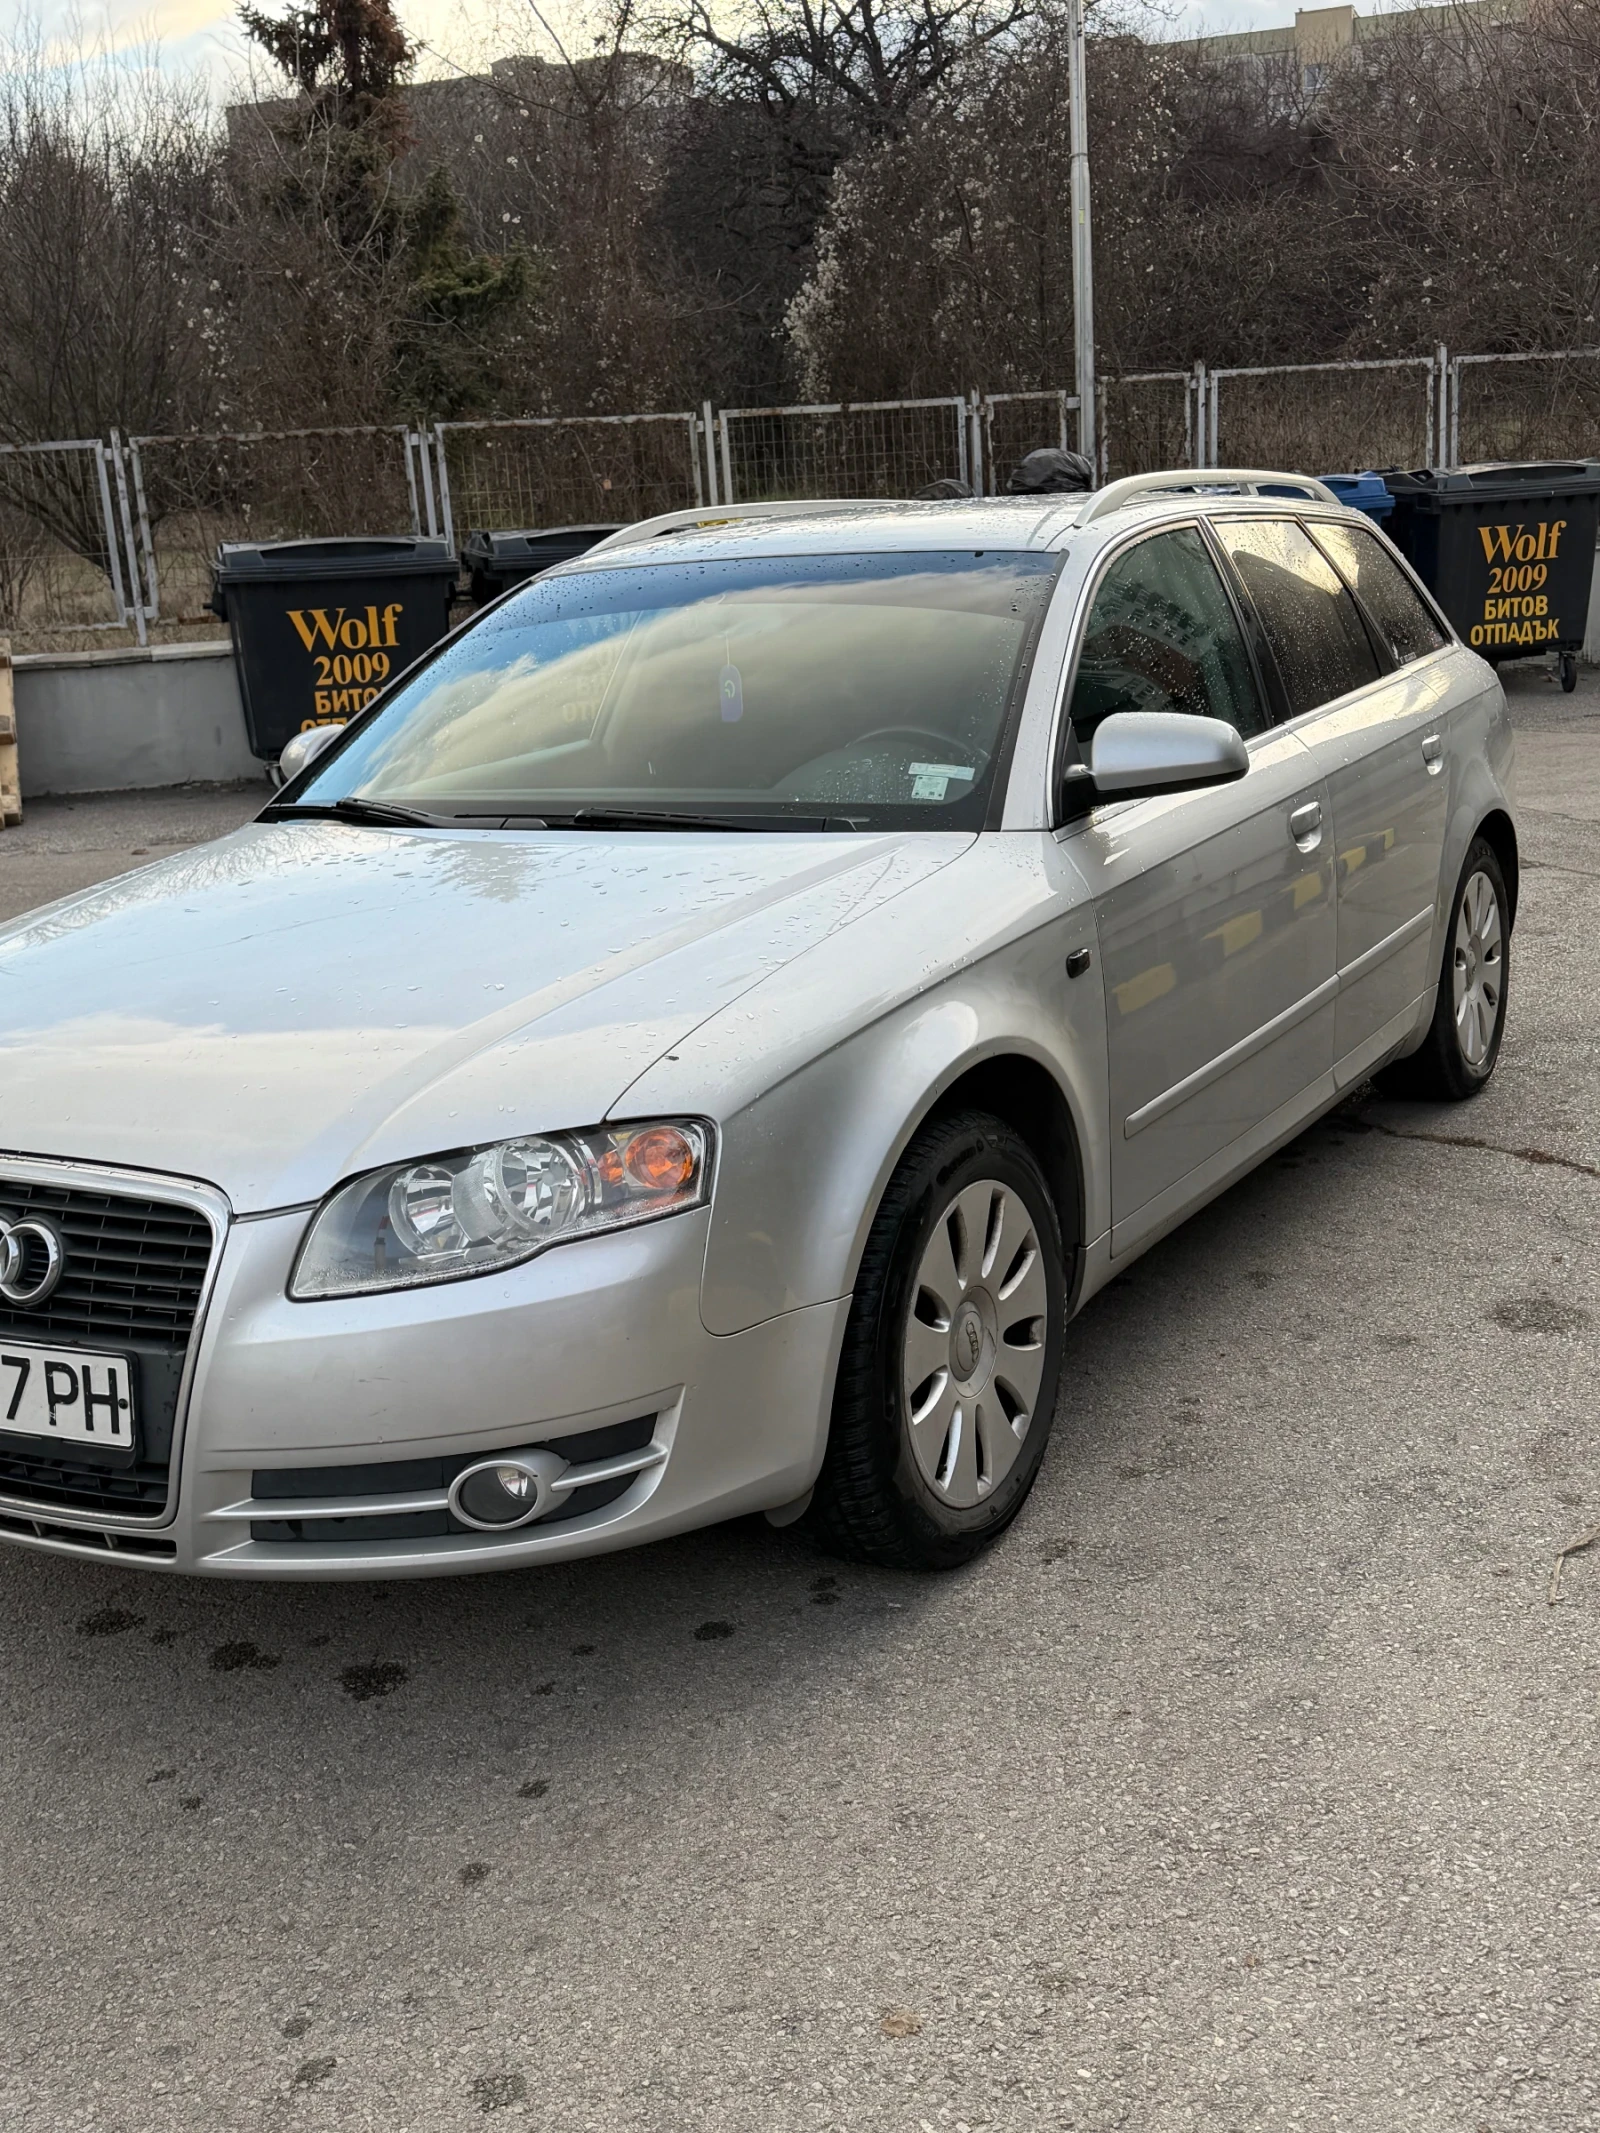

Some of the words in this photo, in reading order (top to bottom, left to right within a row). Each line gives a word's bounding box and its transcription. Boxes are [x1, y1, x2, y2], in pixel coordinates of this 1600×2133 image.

[1477, 520, 1567, 564] Wolf
[1486, 564, 1548, 594] 2009
[1484, 595, 1549, 620] БИТОВ
[286, 603, 403, 653] Wolf
[1470, 618, 1560, 646] ОТПАДЪК
[313, 652, 390, 686] 2009
[314, 686, 386, 714] БИТО
[44, 1360, 121, 1434] PH
